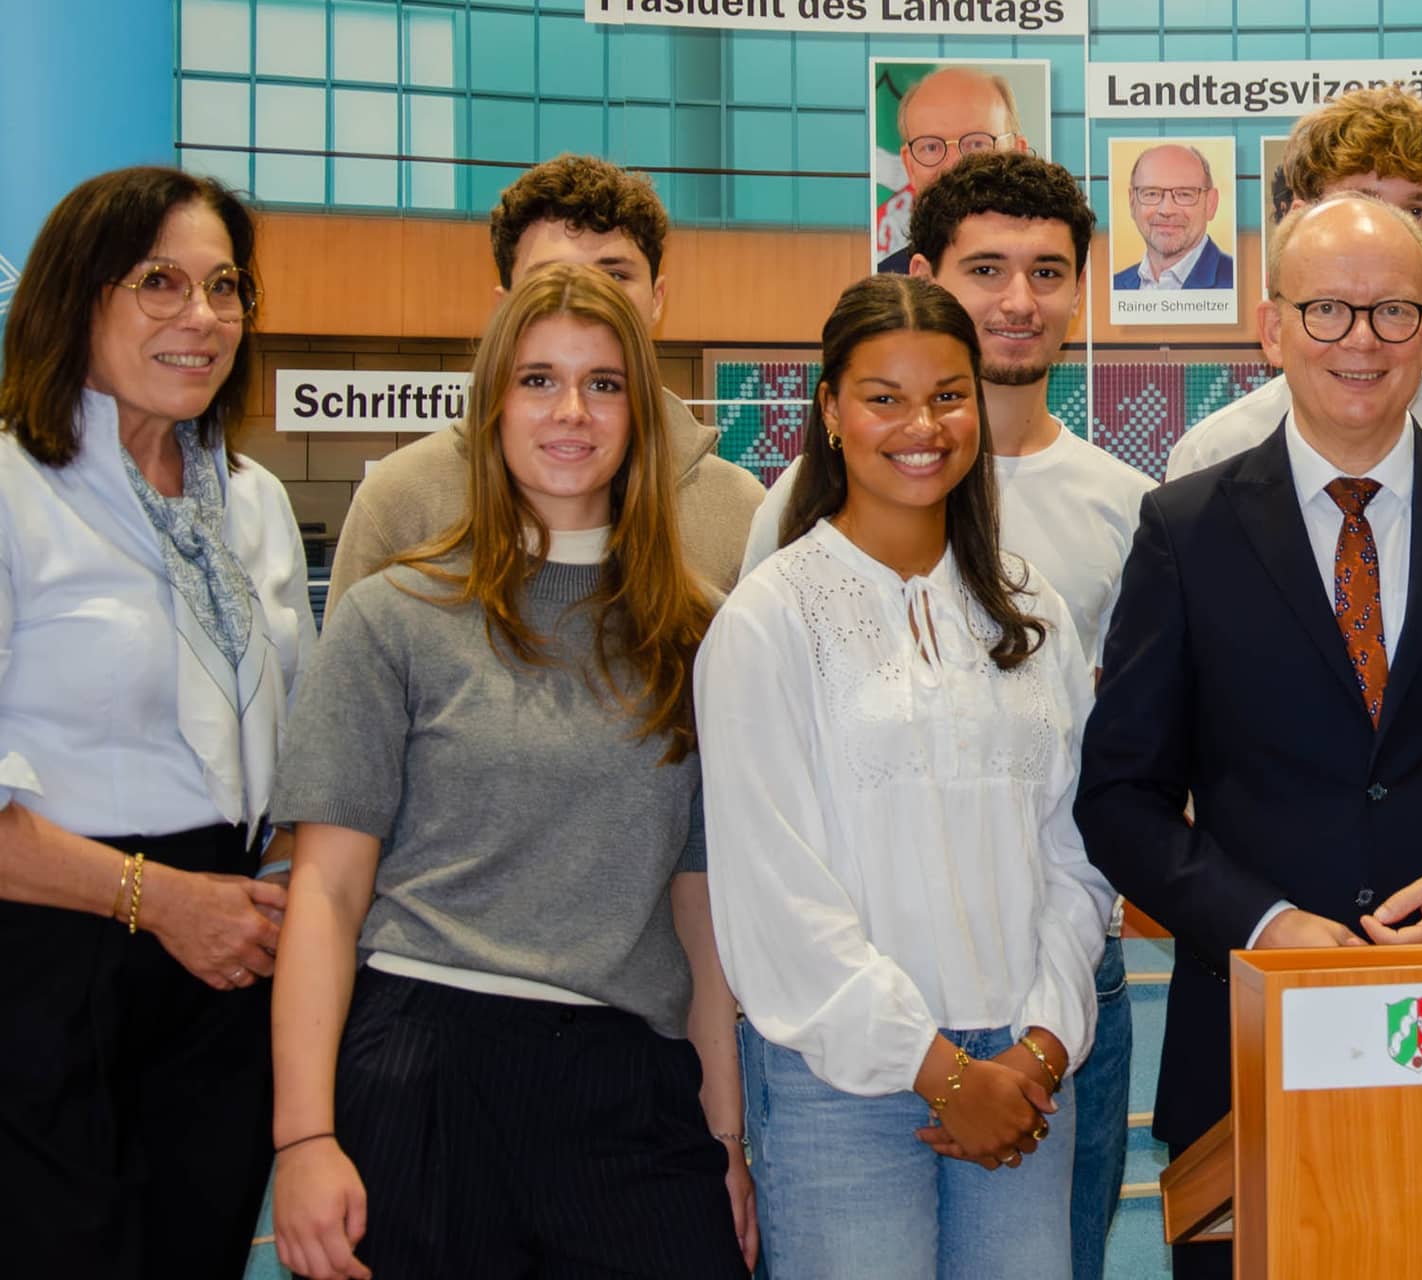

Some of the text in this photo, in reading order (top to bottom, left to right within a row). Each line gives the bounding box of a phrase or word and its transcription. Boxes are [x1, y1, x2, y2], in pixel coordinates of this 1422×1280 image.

[798, 0, 868, 20] des
[881, 0, 1064, 30] Landtags
[1118, 299, 1230, 313] Rainer Schmeltzer
[293, 383, 465, 419] Schriftfü
